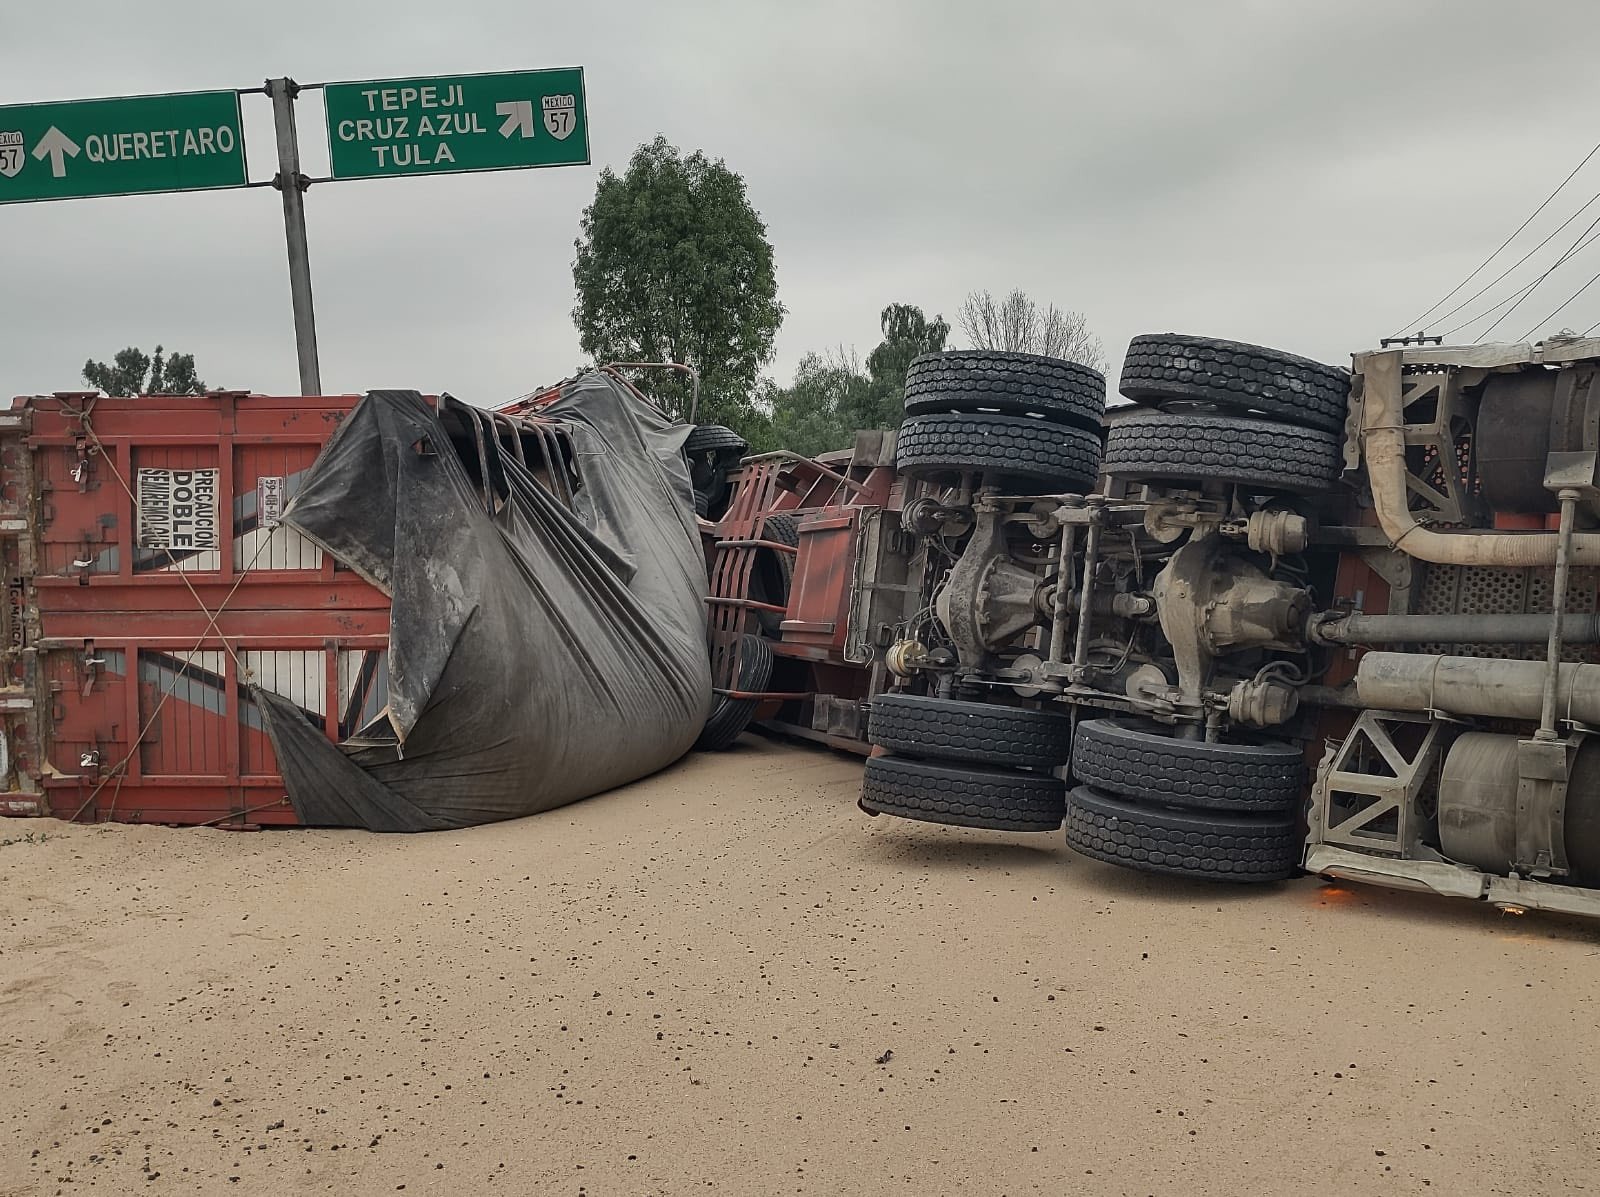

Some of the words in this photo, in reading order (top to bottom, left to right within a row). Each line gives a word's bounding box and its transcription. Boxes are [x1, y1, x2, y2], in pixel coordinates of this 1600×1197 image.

[361, 84, 464, 112] TEPEJI
[544, 96, 573, 108] MEXICO
[338, 116, 410, 142] CRUZ
[417, 112, 487, 137] AZUL
[550, 111, 569, 133] 57
[0, 133, 21, 144] EXICO
[85, 125, 235, 163] QUERETARO
[0, 149, 18, 170] 57
[371, 142, 456, 168] TULA
[172, 471, 193, 547] DOBLE
